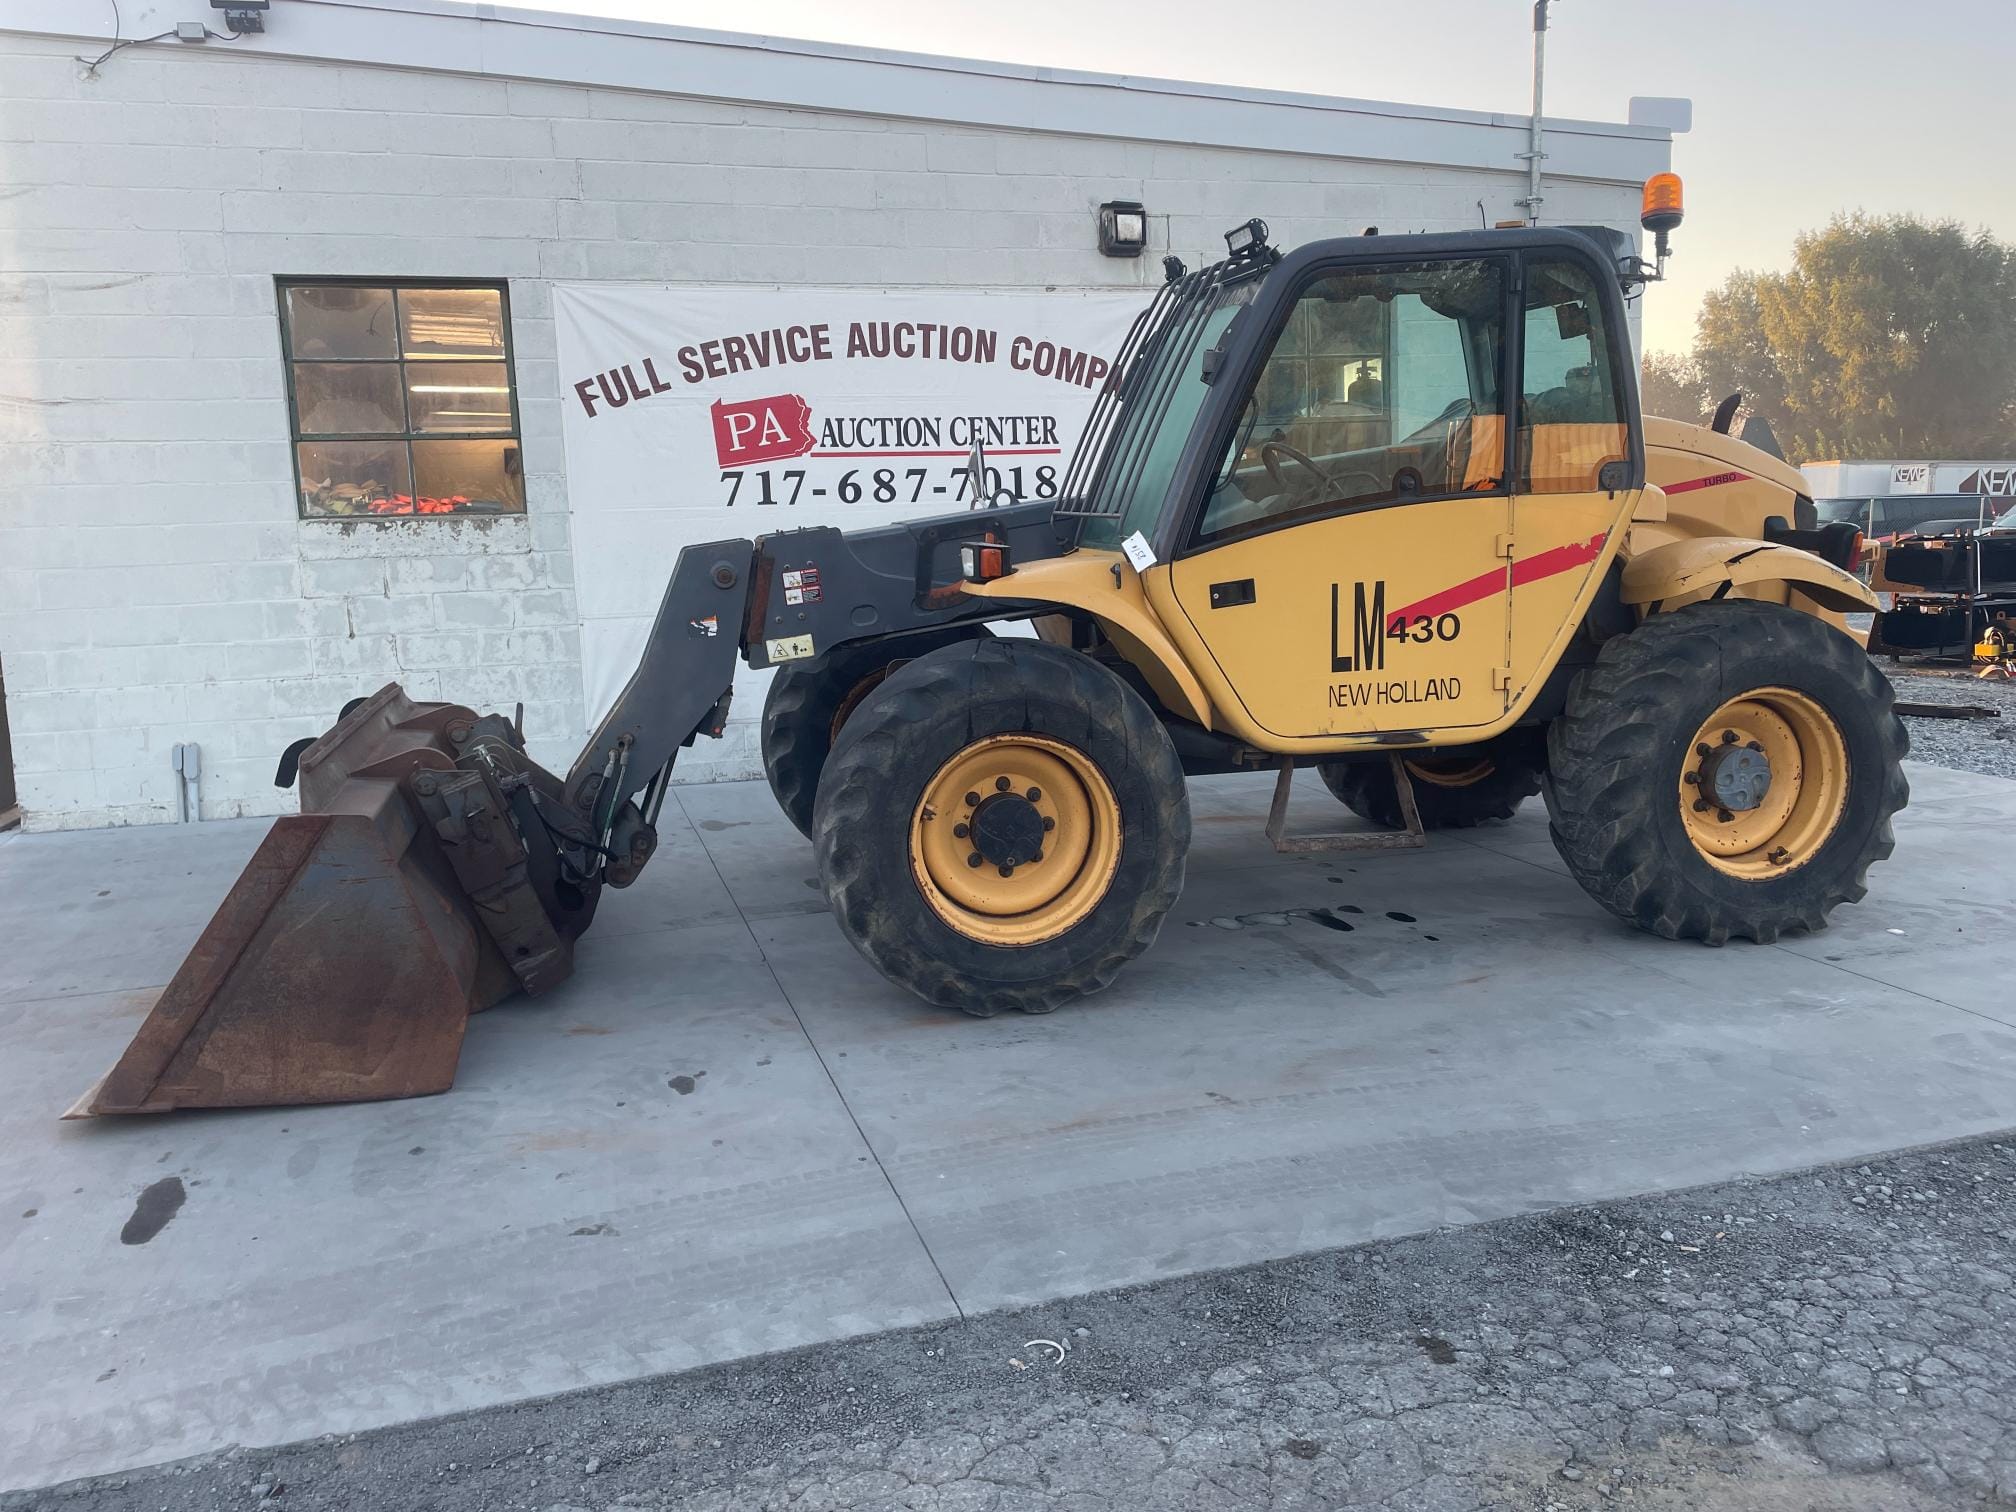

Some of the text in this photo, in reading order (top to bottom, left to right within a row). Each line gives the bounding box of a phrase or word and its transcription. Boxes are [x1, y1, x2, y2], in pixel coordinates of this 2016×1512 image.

[574, 357, 672, 418] FULL
[677, 324, 833, 384] SERVICE
[846, 322, 998, 364] AUCTION
[723, 407, 792, 452] PA
[820, 415, 1060, 448] AUCTION CENTER
[720, 465, 1058, 507] 717-687-7018
[1703, 472, 1737, 487] TURBO
[1328, 677, 1461, 708] NEW HOLLAND
